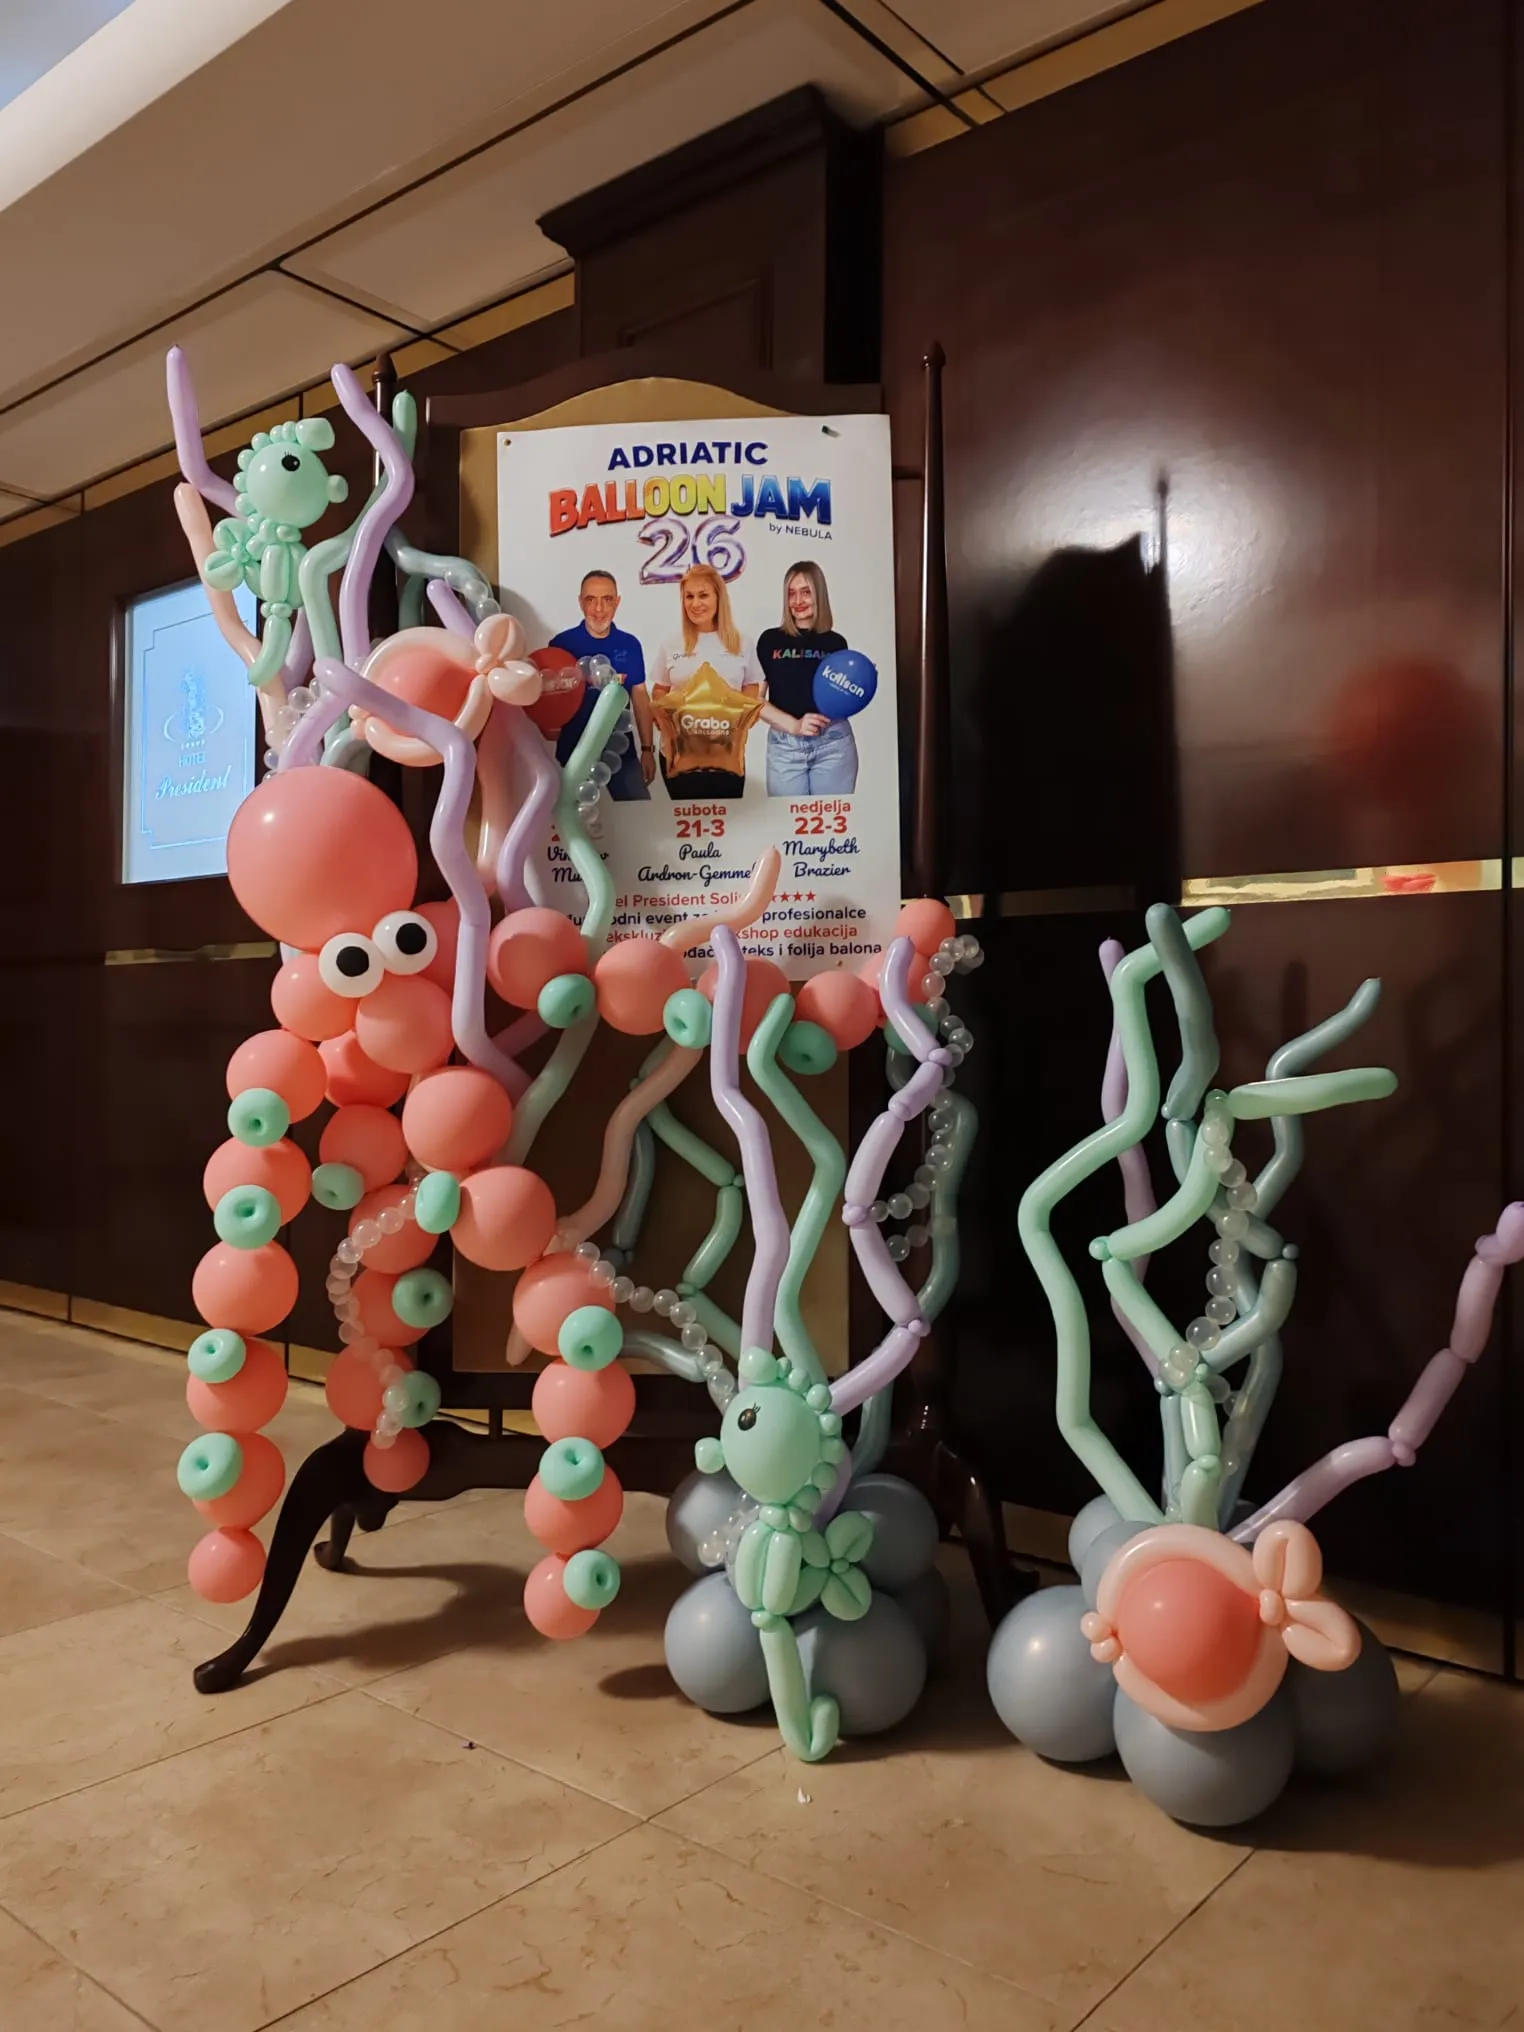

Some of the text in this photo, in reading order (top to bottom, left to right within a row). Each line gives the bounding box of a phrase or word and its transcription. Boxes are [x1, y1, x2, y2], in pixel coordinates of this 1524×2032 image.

[608, 441, 768, 470] ADRIATIC
[549, 474, 832, 537] BALLOON JAM
[769, 522, 832, 540] by NEBULA
[638, 514, 747, 585] 26
[822, 665, 865, 698] kalisan
[681, 714, 730, 730] Grabo
[178, 751, 206, 767] HOTEL
[155, 764, 232, 800] President
[673, 803, 727, 817] subota
[790, 799, 851, 815] nedjelja
[676, 819, 725, 838] 21-3
[794, 815, 848, 835] 22-3
[678, 841, 722, 860] Paula
[782, 837, 861, 862] Marybeth
[637, 862, 757, 887] Ardron-Gemme
[793, 861, 851, 878] Brazier
[633, 892, 706, 908] President
[710, 891, 741, 904] Soli
[646, 912, 688, 925] event
[762, 906, 867, 924] profesionalce
[784, 924, 858, 940] edukacija
[778, 944, 783, 956] i
[787, 942, 825, 959] folija
[829, 942, 883, 956] balona
